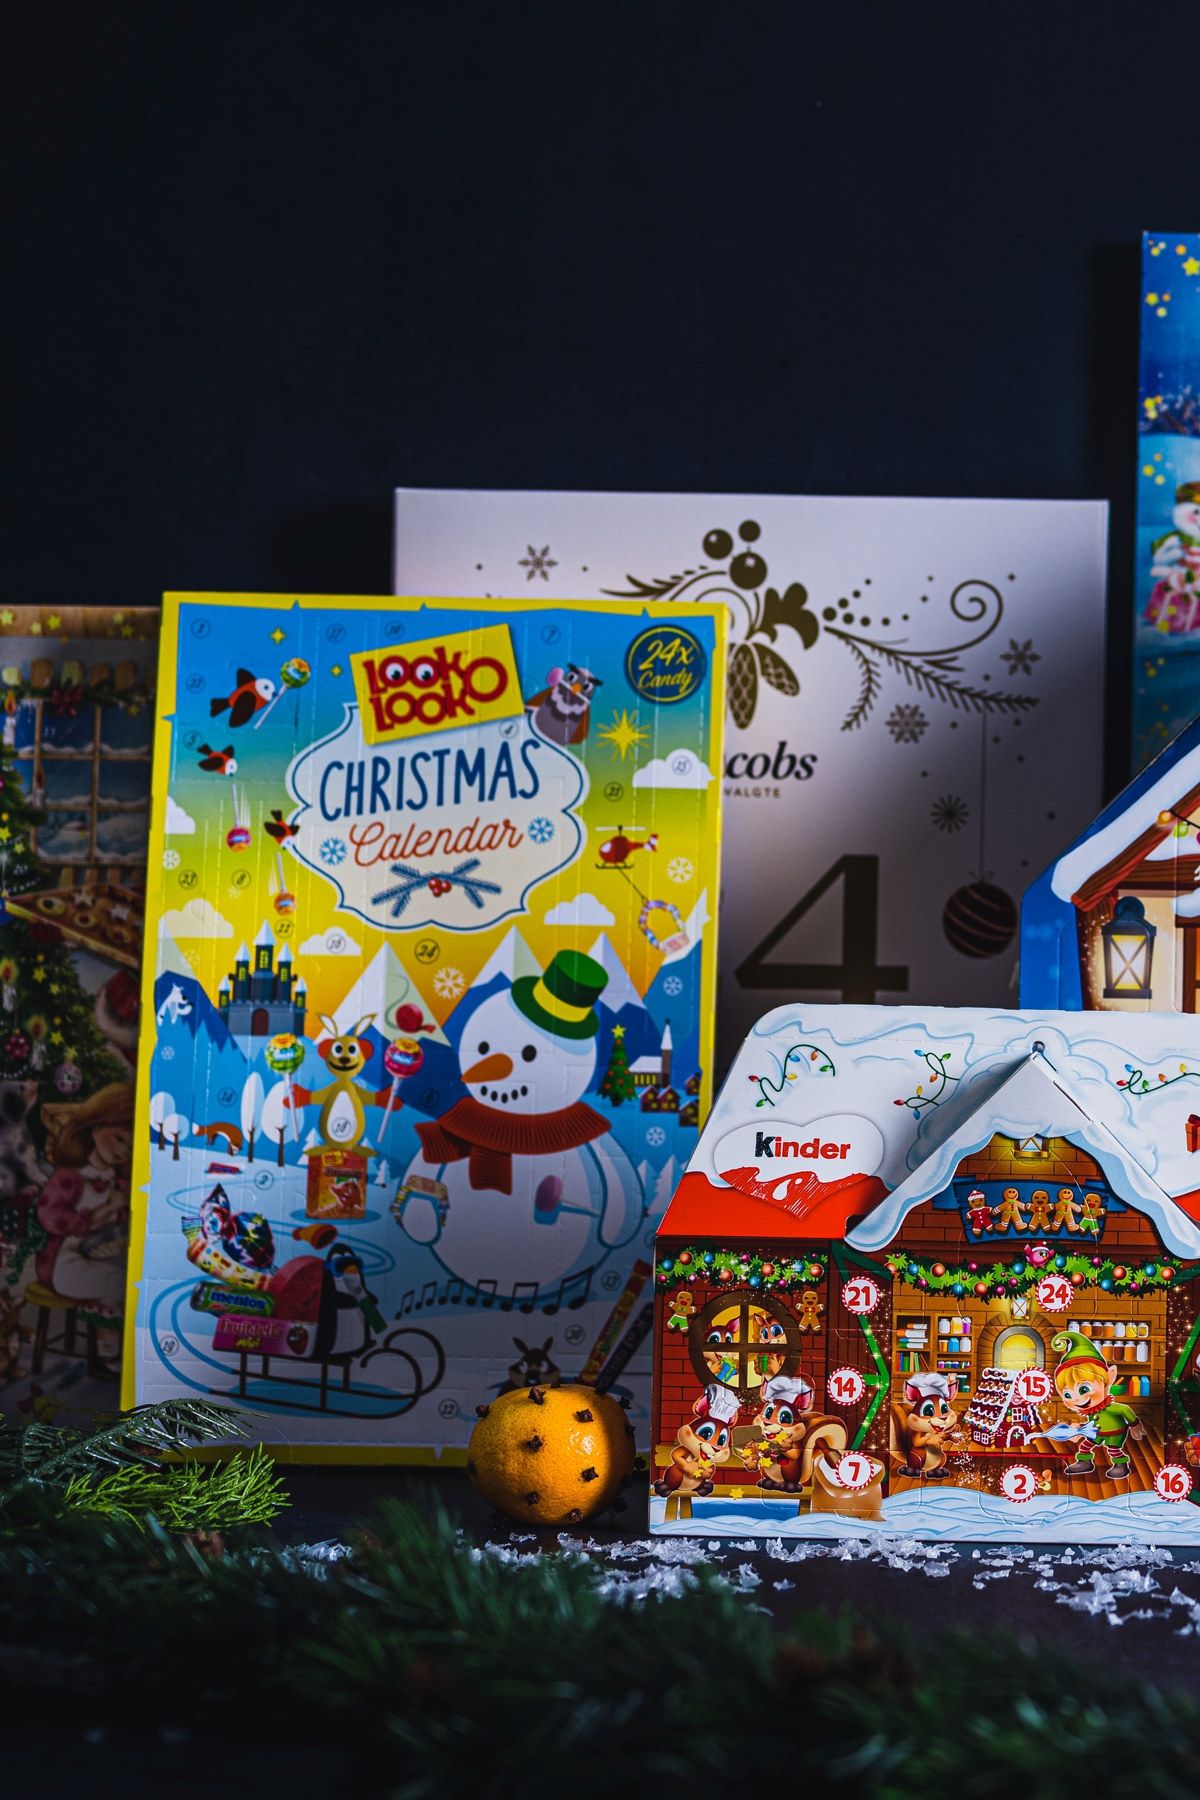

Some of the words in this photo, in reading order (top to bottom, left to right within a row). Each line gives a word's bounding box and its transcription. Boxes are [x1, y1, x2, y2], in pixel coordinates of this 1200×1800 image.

[639, 637, 695, 671] 24x
[638, 667, 693, 695] Candy
[722, 740, 818, 781] cobs
[319, 739, 540, 822] CHRISTMAS
[348, 815, 524, 868] Calendar
[849, 1286, 873, 1307] 21
[1042, 1284, 1068, 1305] 24
[833, 1376, 858, 1397] 14
[1022, 1376, 1045, 1397] 15
[848, 1461, 860, 1482] 7
[1013, 1475, 1027, 1495] 2
[1161, 1472, 1185, 1494] 16
